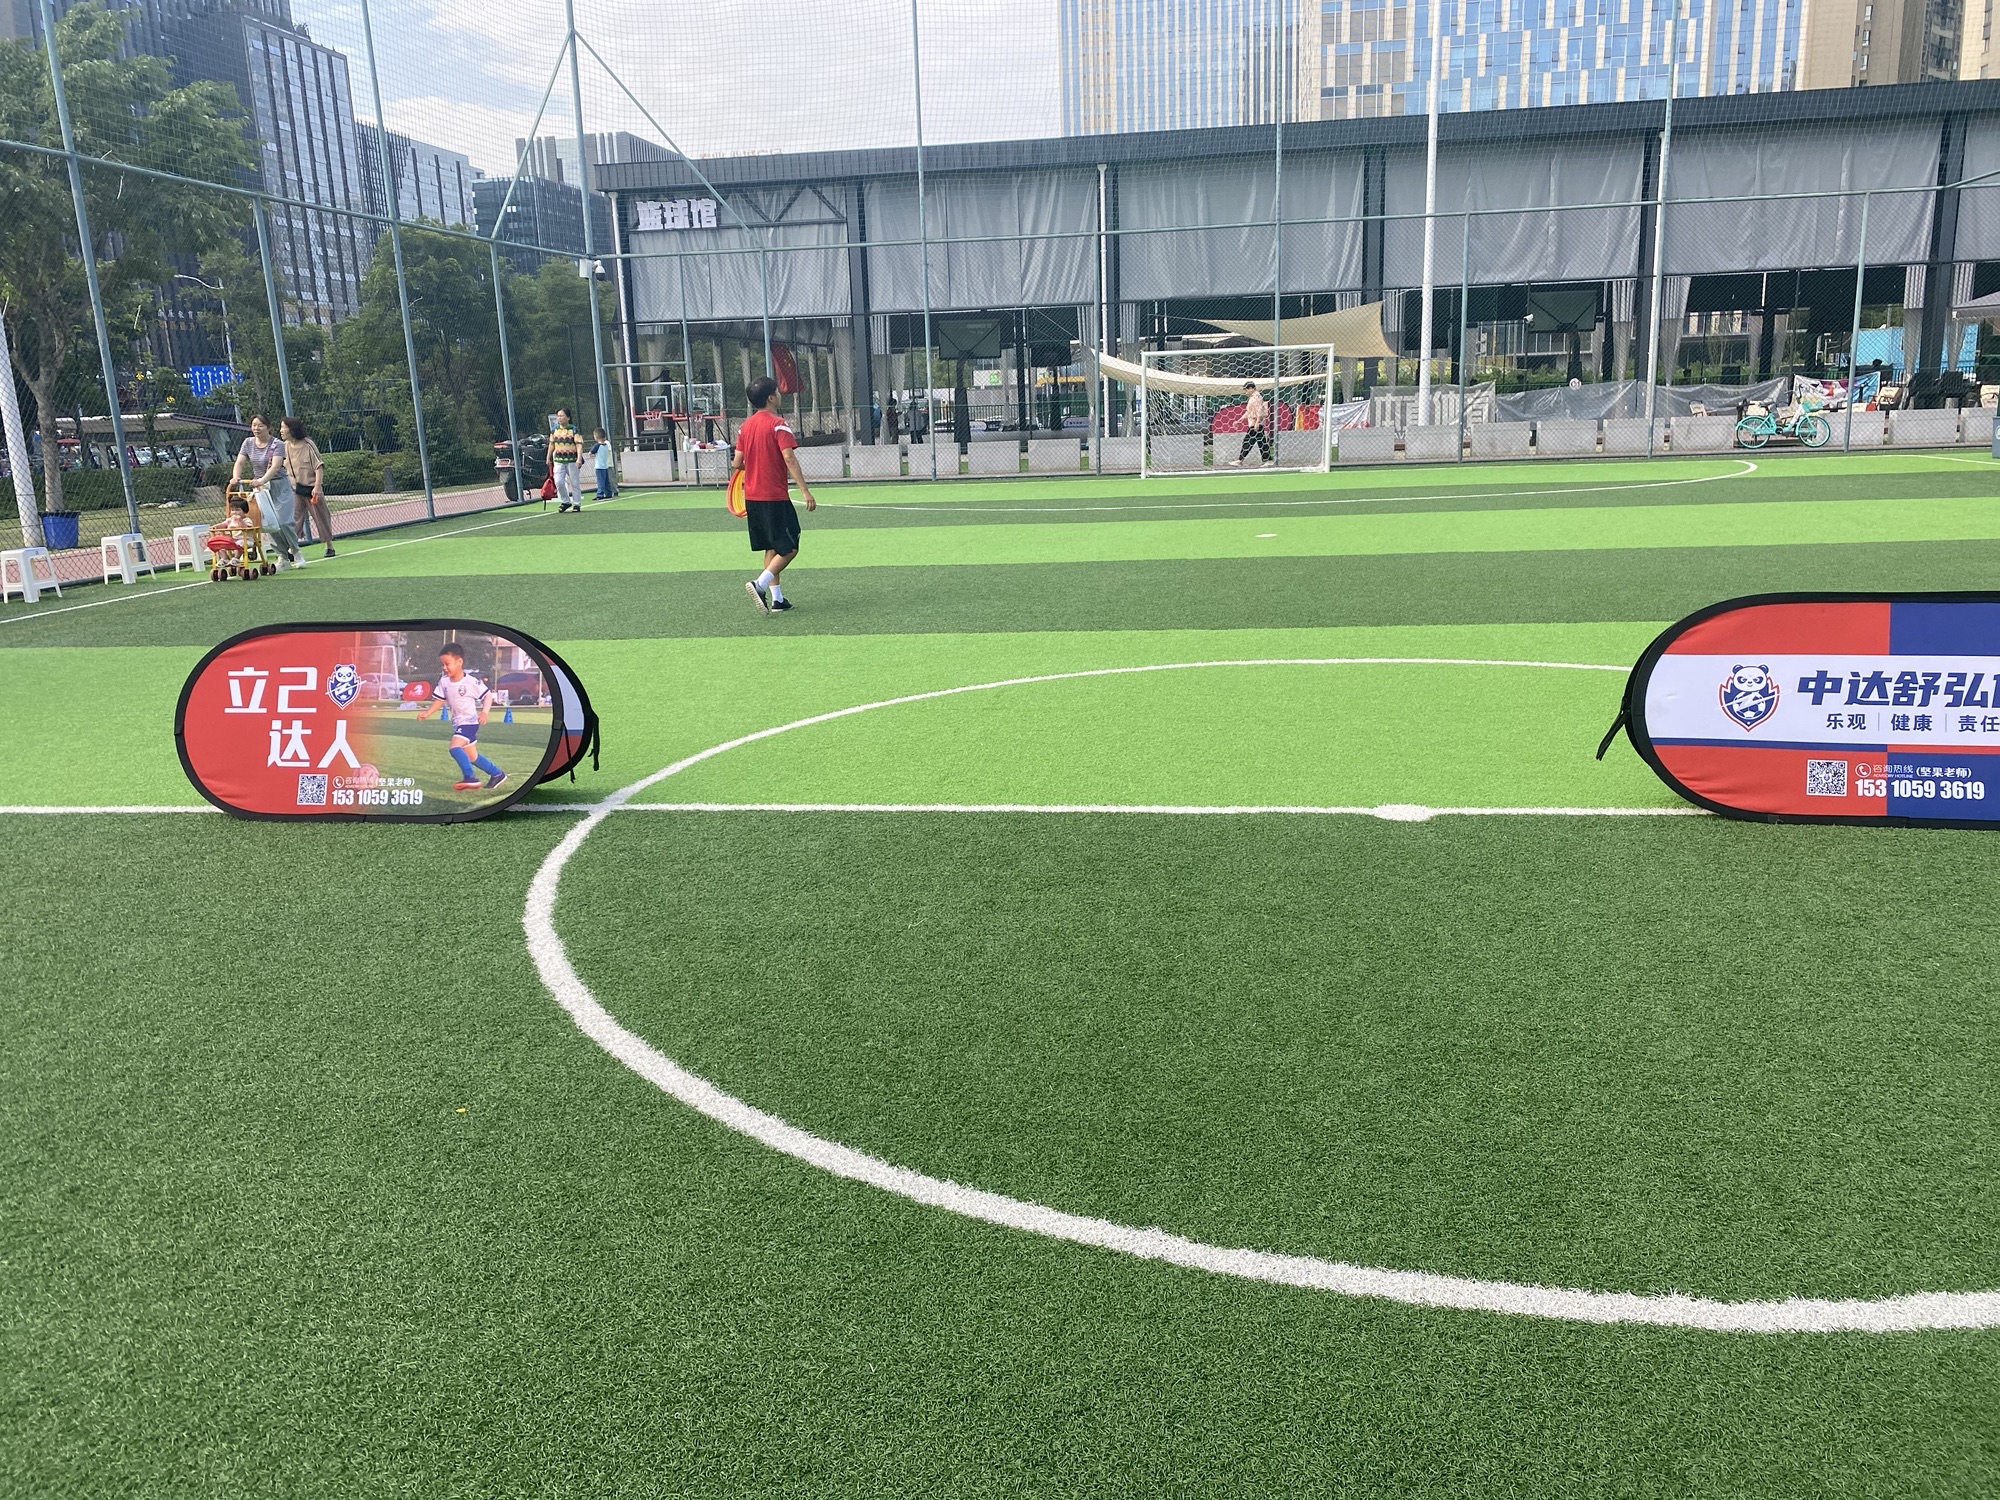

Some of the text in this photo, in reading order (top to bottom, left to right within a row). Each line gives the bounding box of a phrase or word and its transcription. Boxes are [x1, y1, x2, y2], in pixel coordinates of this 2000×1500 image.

[635, 198, 718, 231] 篮球馆
[224, 666, 318, 714] 立己
[1797, 669, 2000, 709] 中达舒弘
[1826, 713, 2000, 733] 乐观 健康 责任
[267, 719, 362, 769] 达人
[1873, 764, 1972, 778] 咨询热线 (坚果老师)
[332, 789, 423, 805] 153 1059 3619
[1855, 779, 1985, 800] 153 1059 3619
